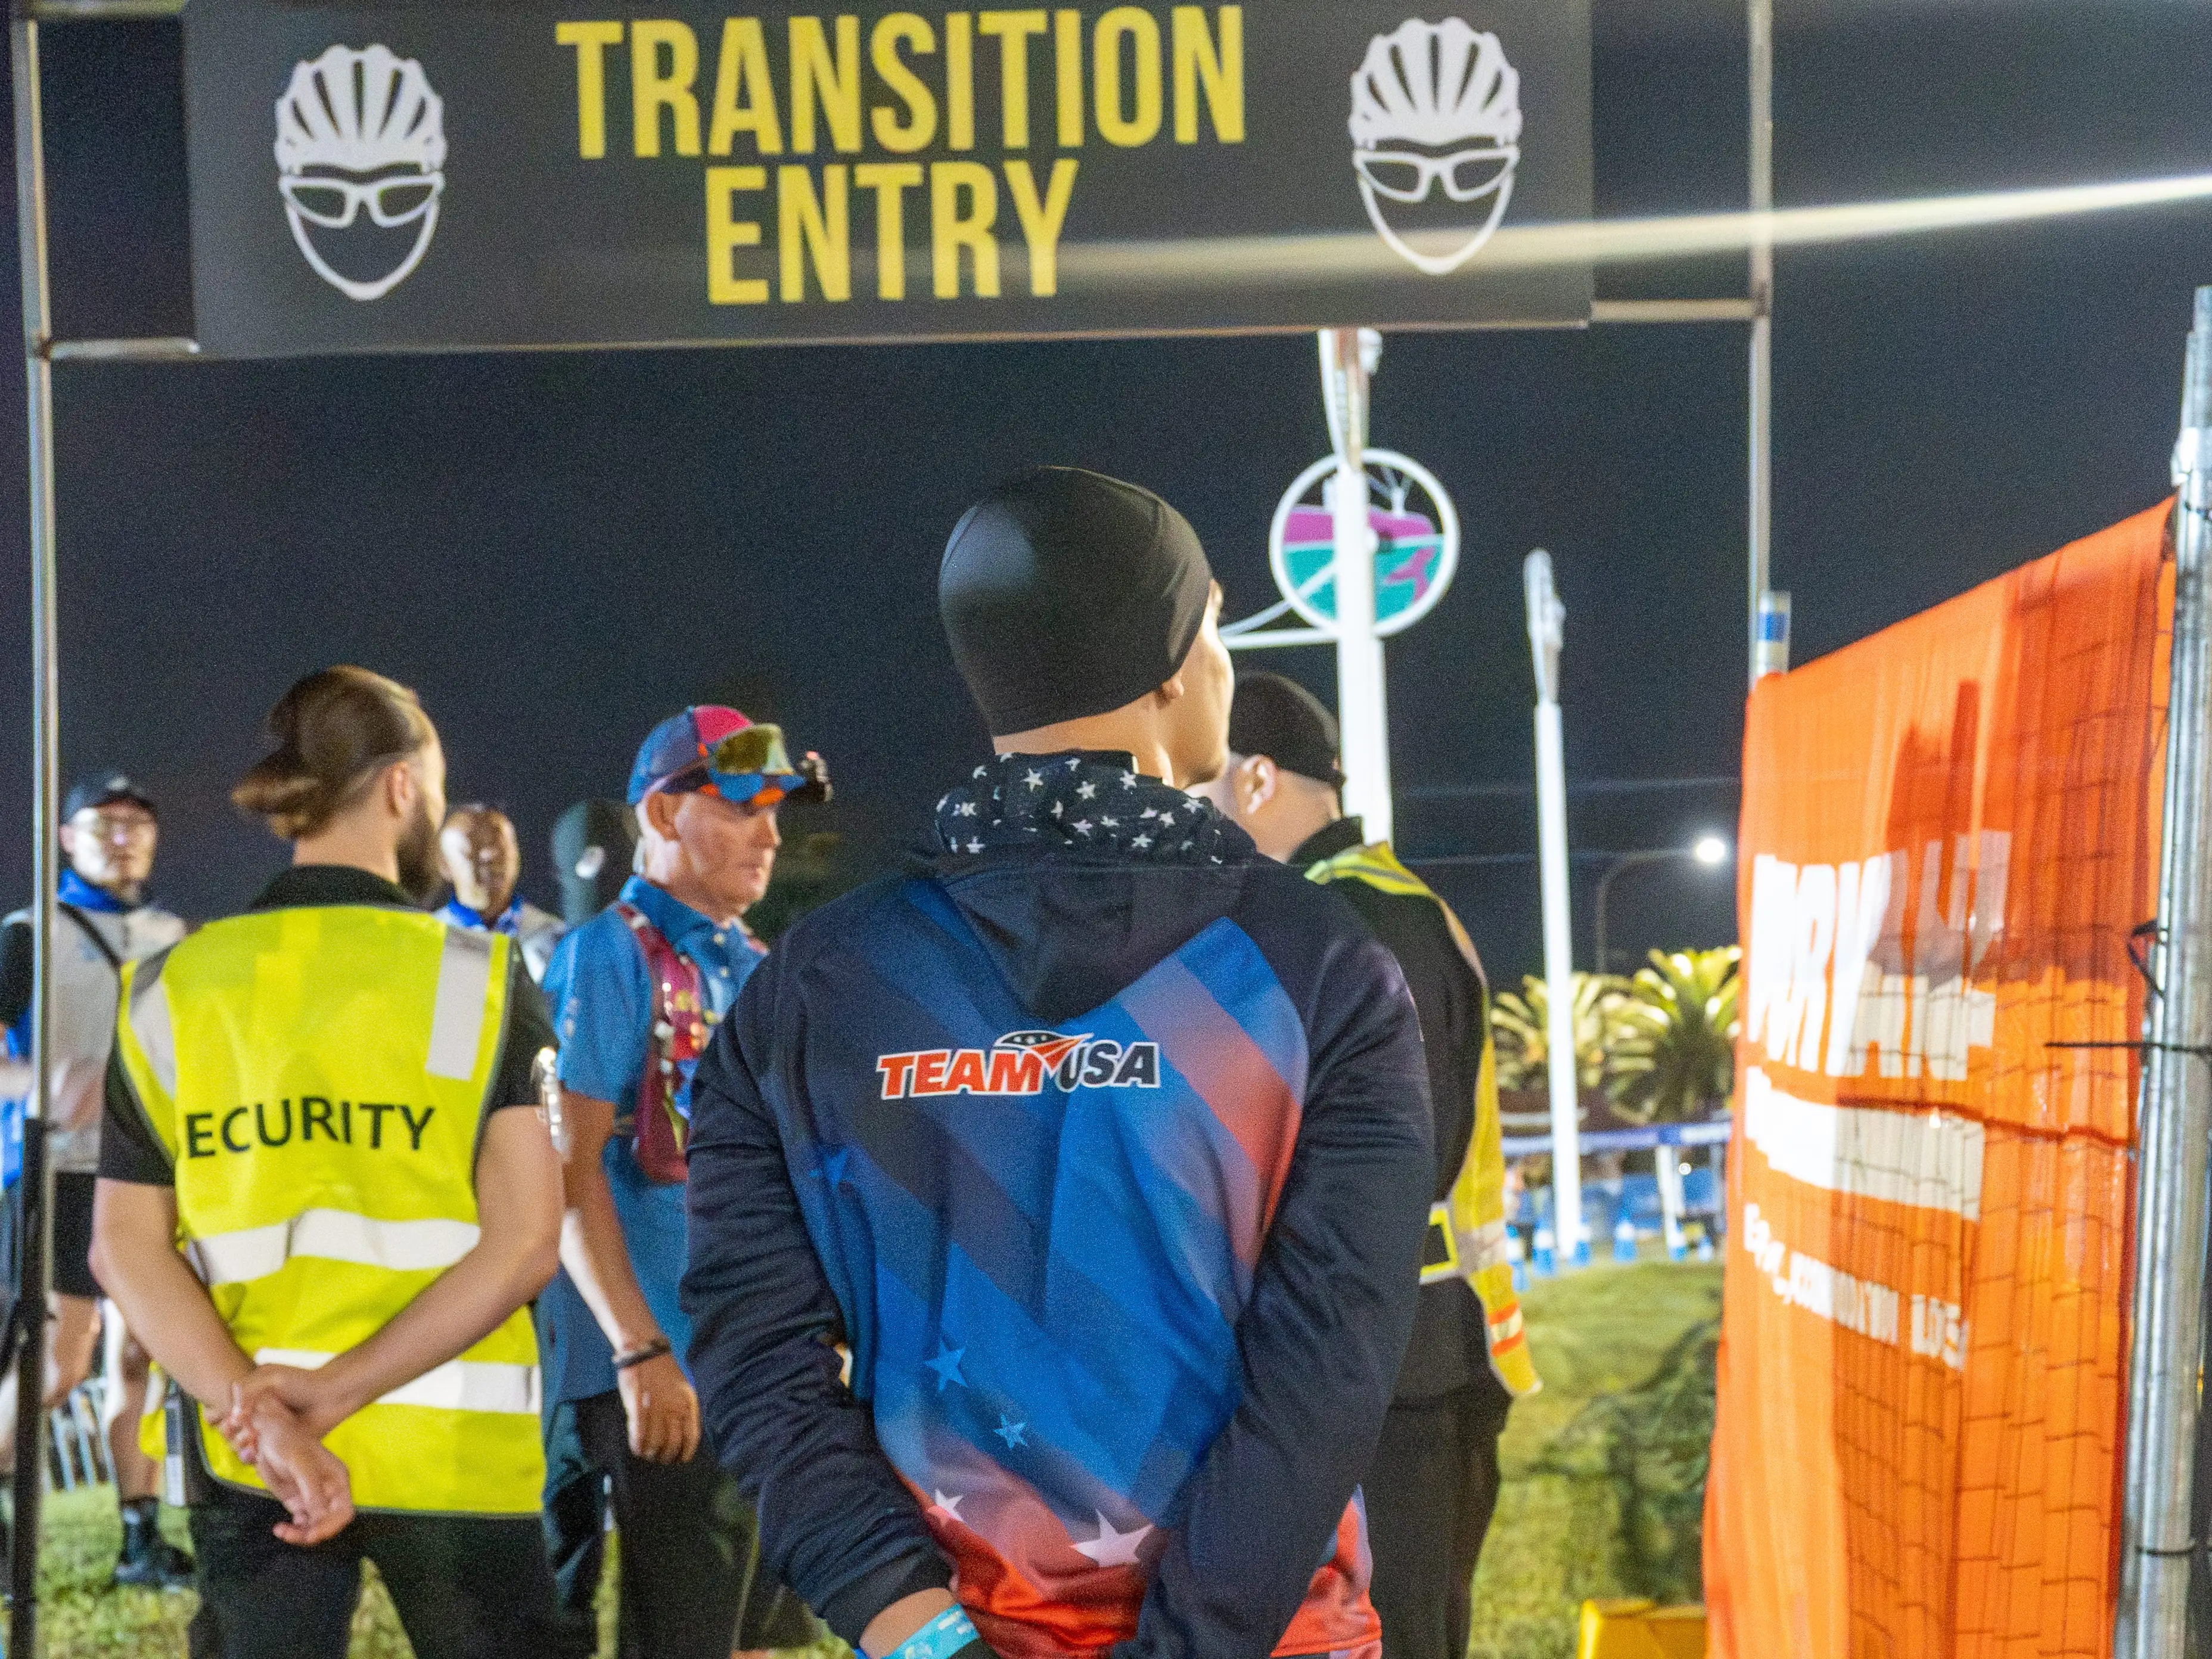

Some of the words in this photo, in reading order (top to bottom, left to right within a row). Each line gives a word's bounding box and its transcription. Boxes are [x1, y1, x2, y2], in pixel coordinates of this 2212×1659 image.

[555, 5, 1245, 159] TRANSITION
[705, 159, 1079, 306] ENTRY
[876, 1048, 1043, 1101] TEAM
[1055, 1039, 1161, 1093] USA
[185, 1096, 436, 1158] ECURITY
